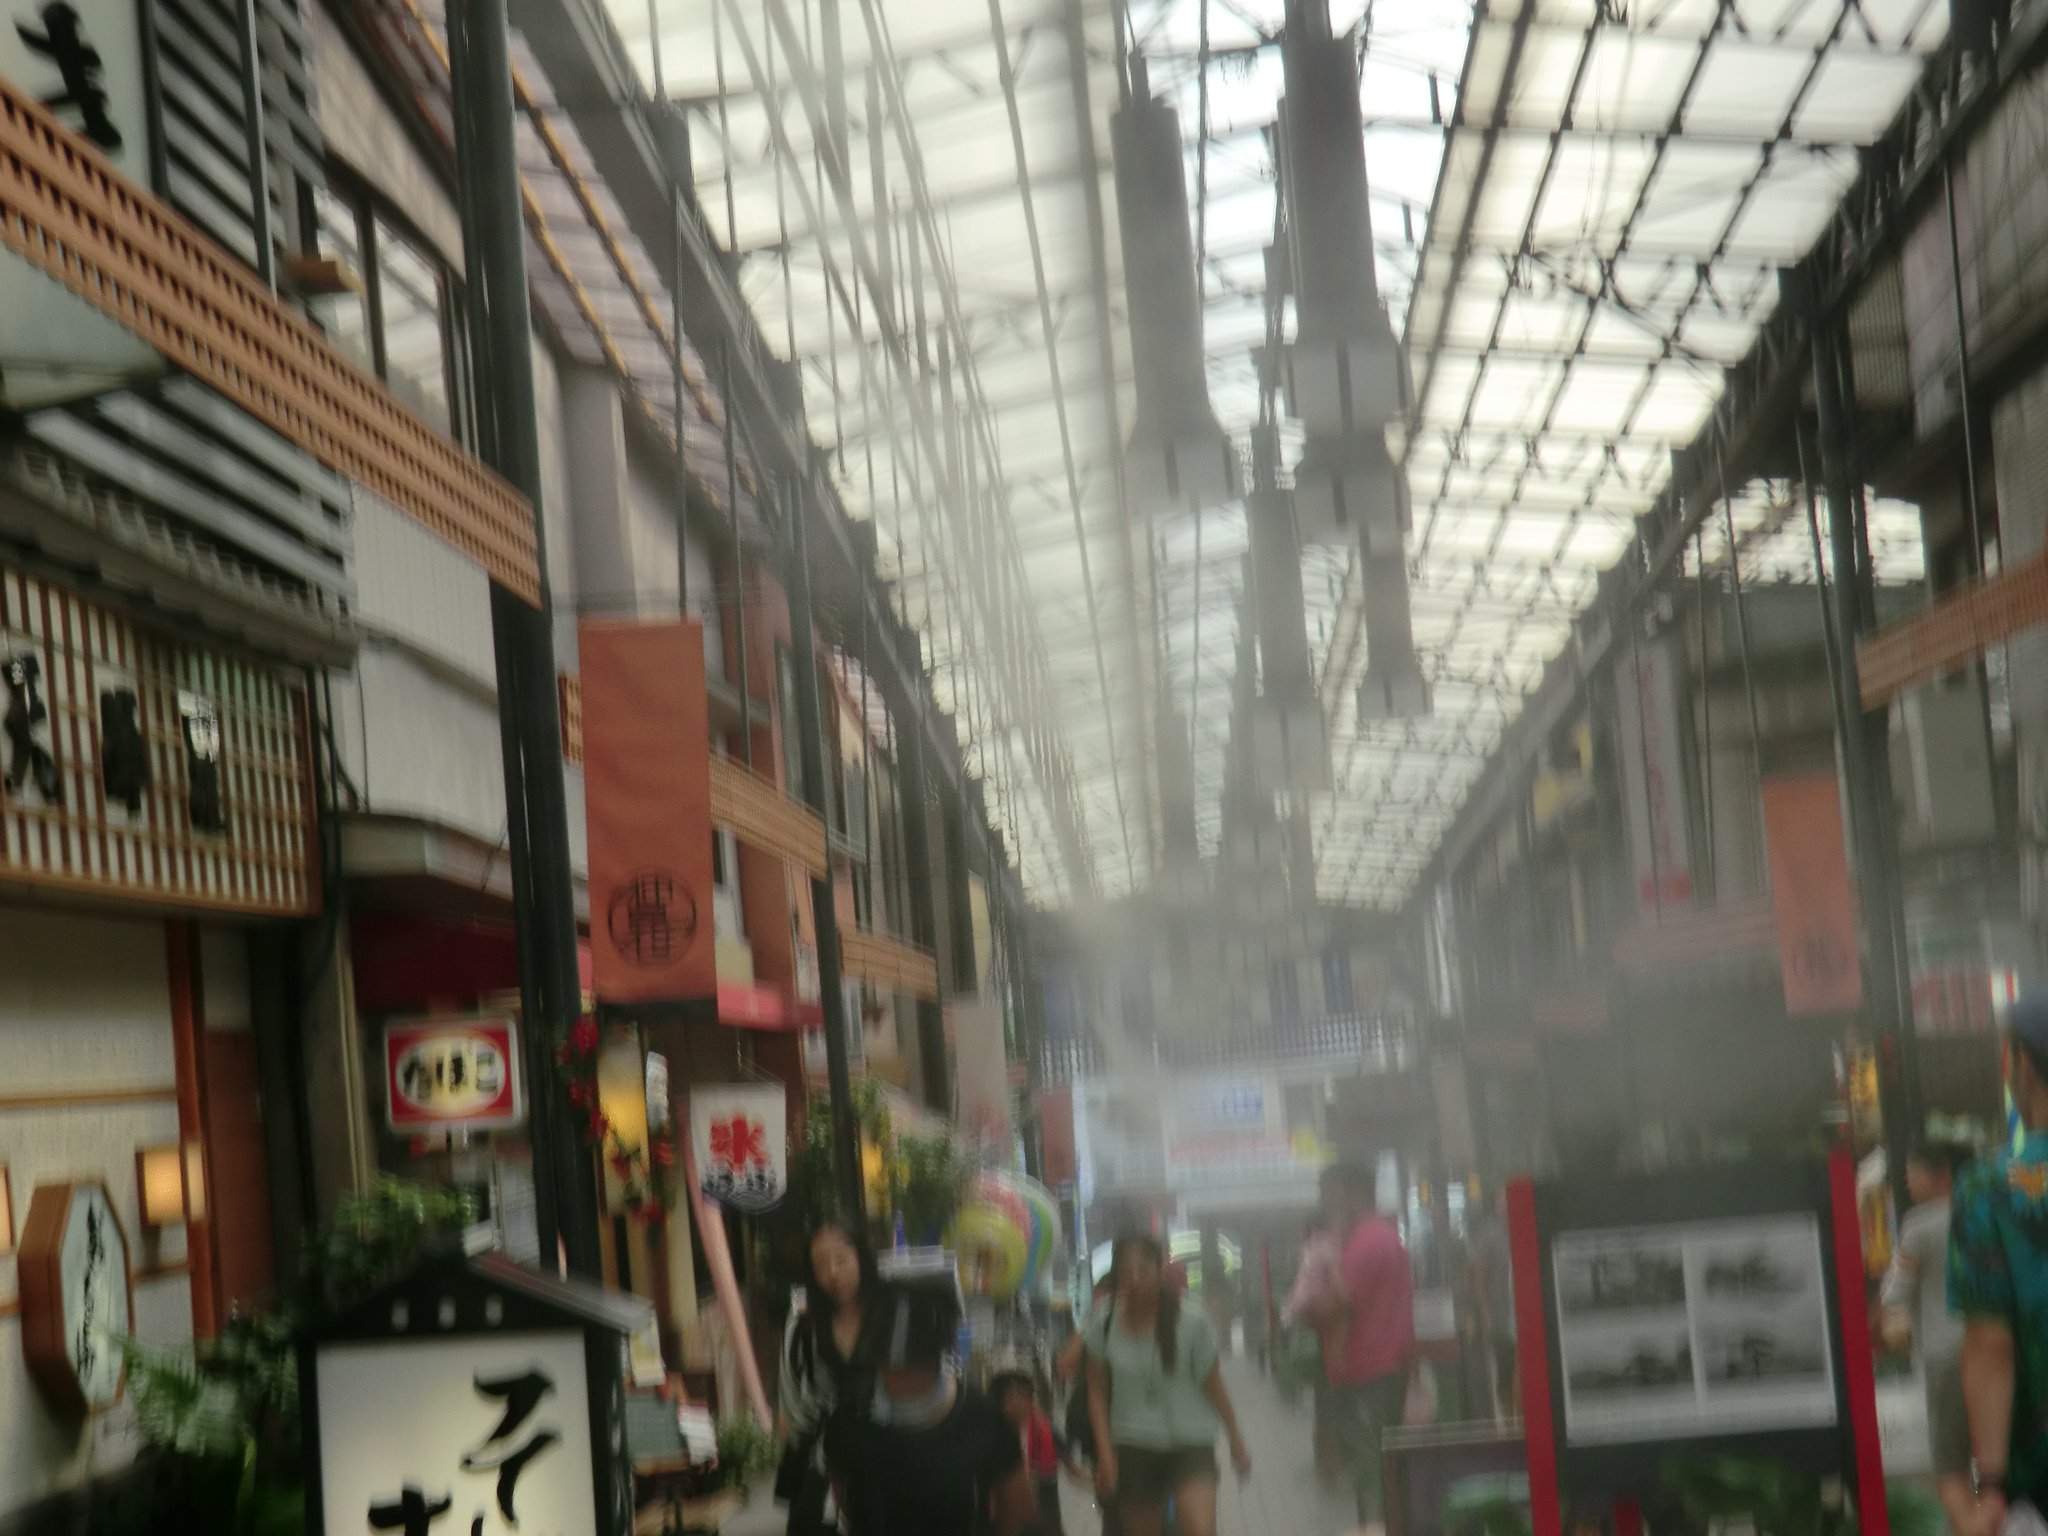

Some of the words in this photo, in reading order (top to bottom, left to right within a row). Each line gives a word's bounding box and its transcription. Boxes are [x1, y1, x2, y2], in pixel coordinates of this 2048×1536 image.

[403, 1046, 499, 1101] たばこ
[709, 1111, 771, 1173] 氷
